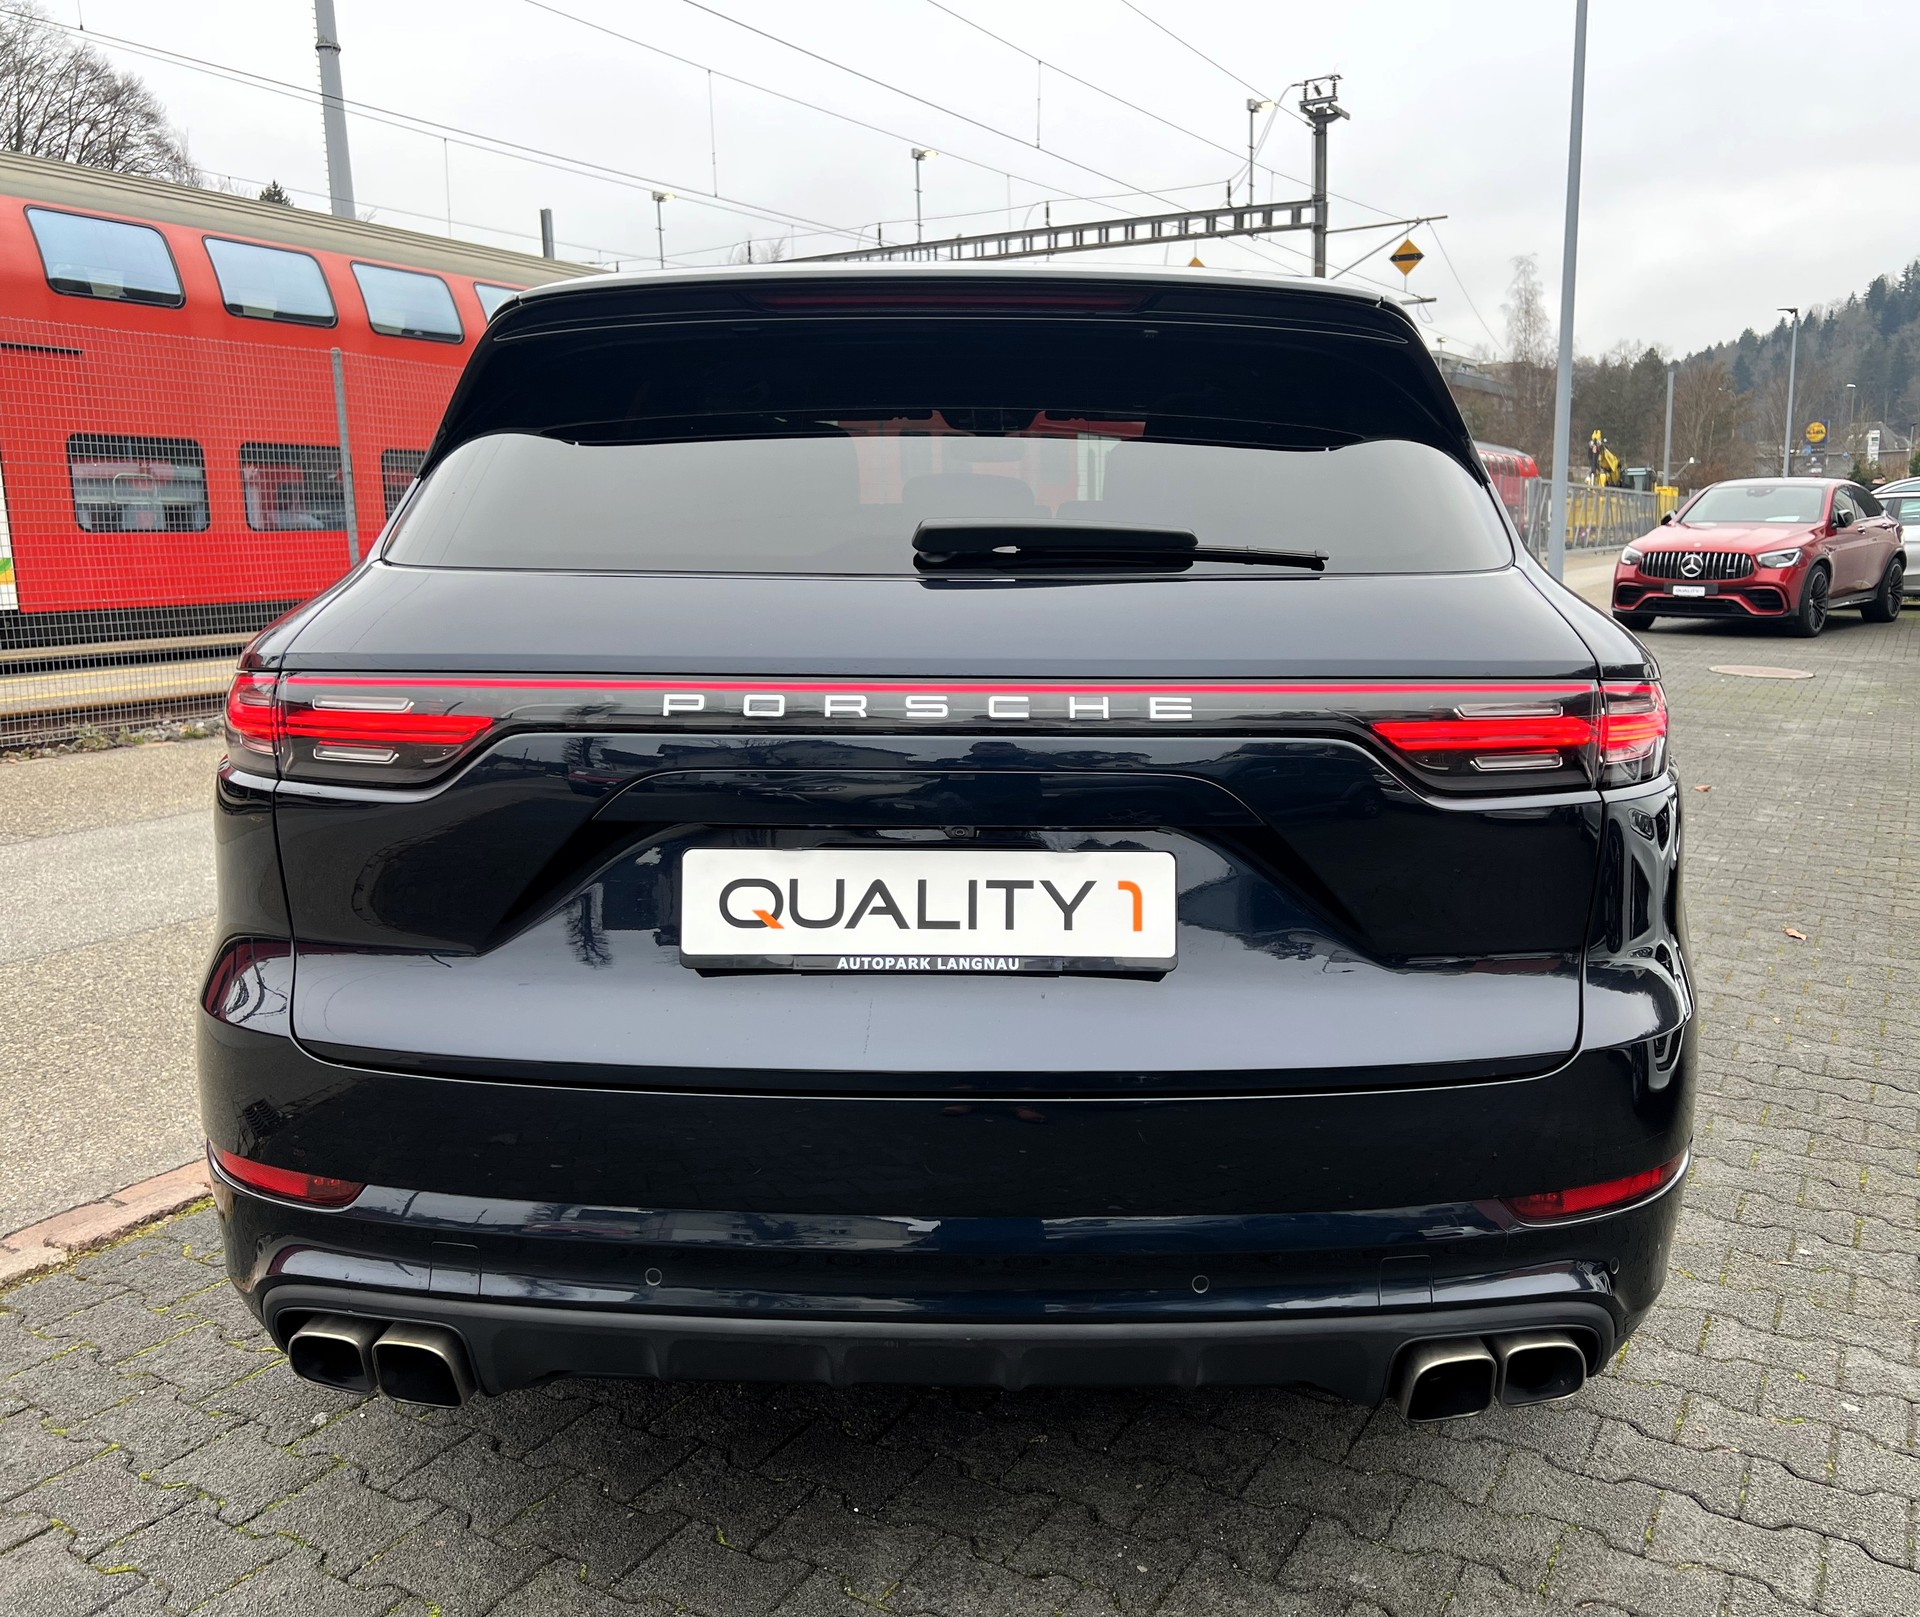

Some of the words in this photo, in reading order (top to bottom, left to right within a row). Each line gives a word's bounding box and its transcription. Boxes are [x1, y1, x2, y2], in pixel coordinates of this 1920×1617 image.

[662, 693, 1195, 721] PORSCHE
[837, 957, 931, 970] AUTOPARK
[937, 957, 1020, 970] LANGNAU
